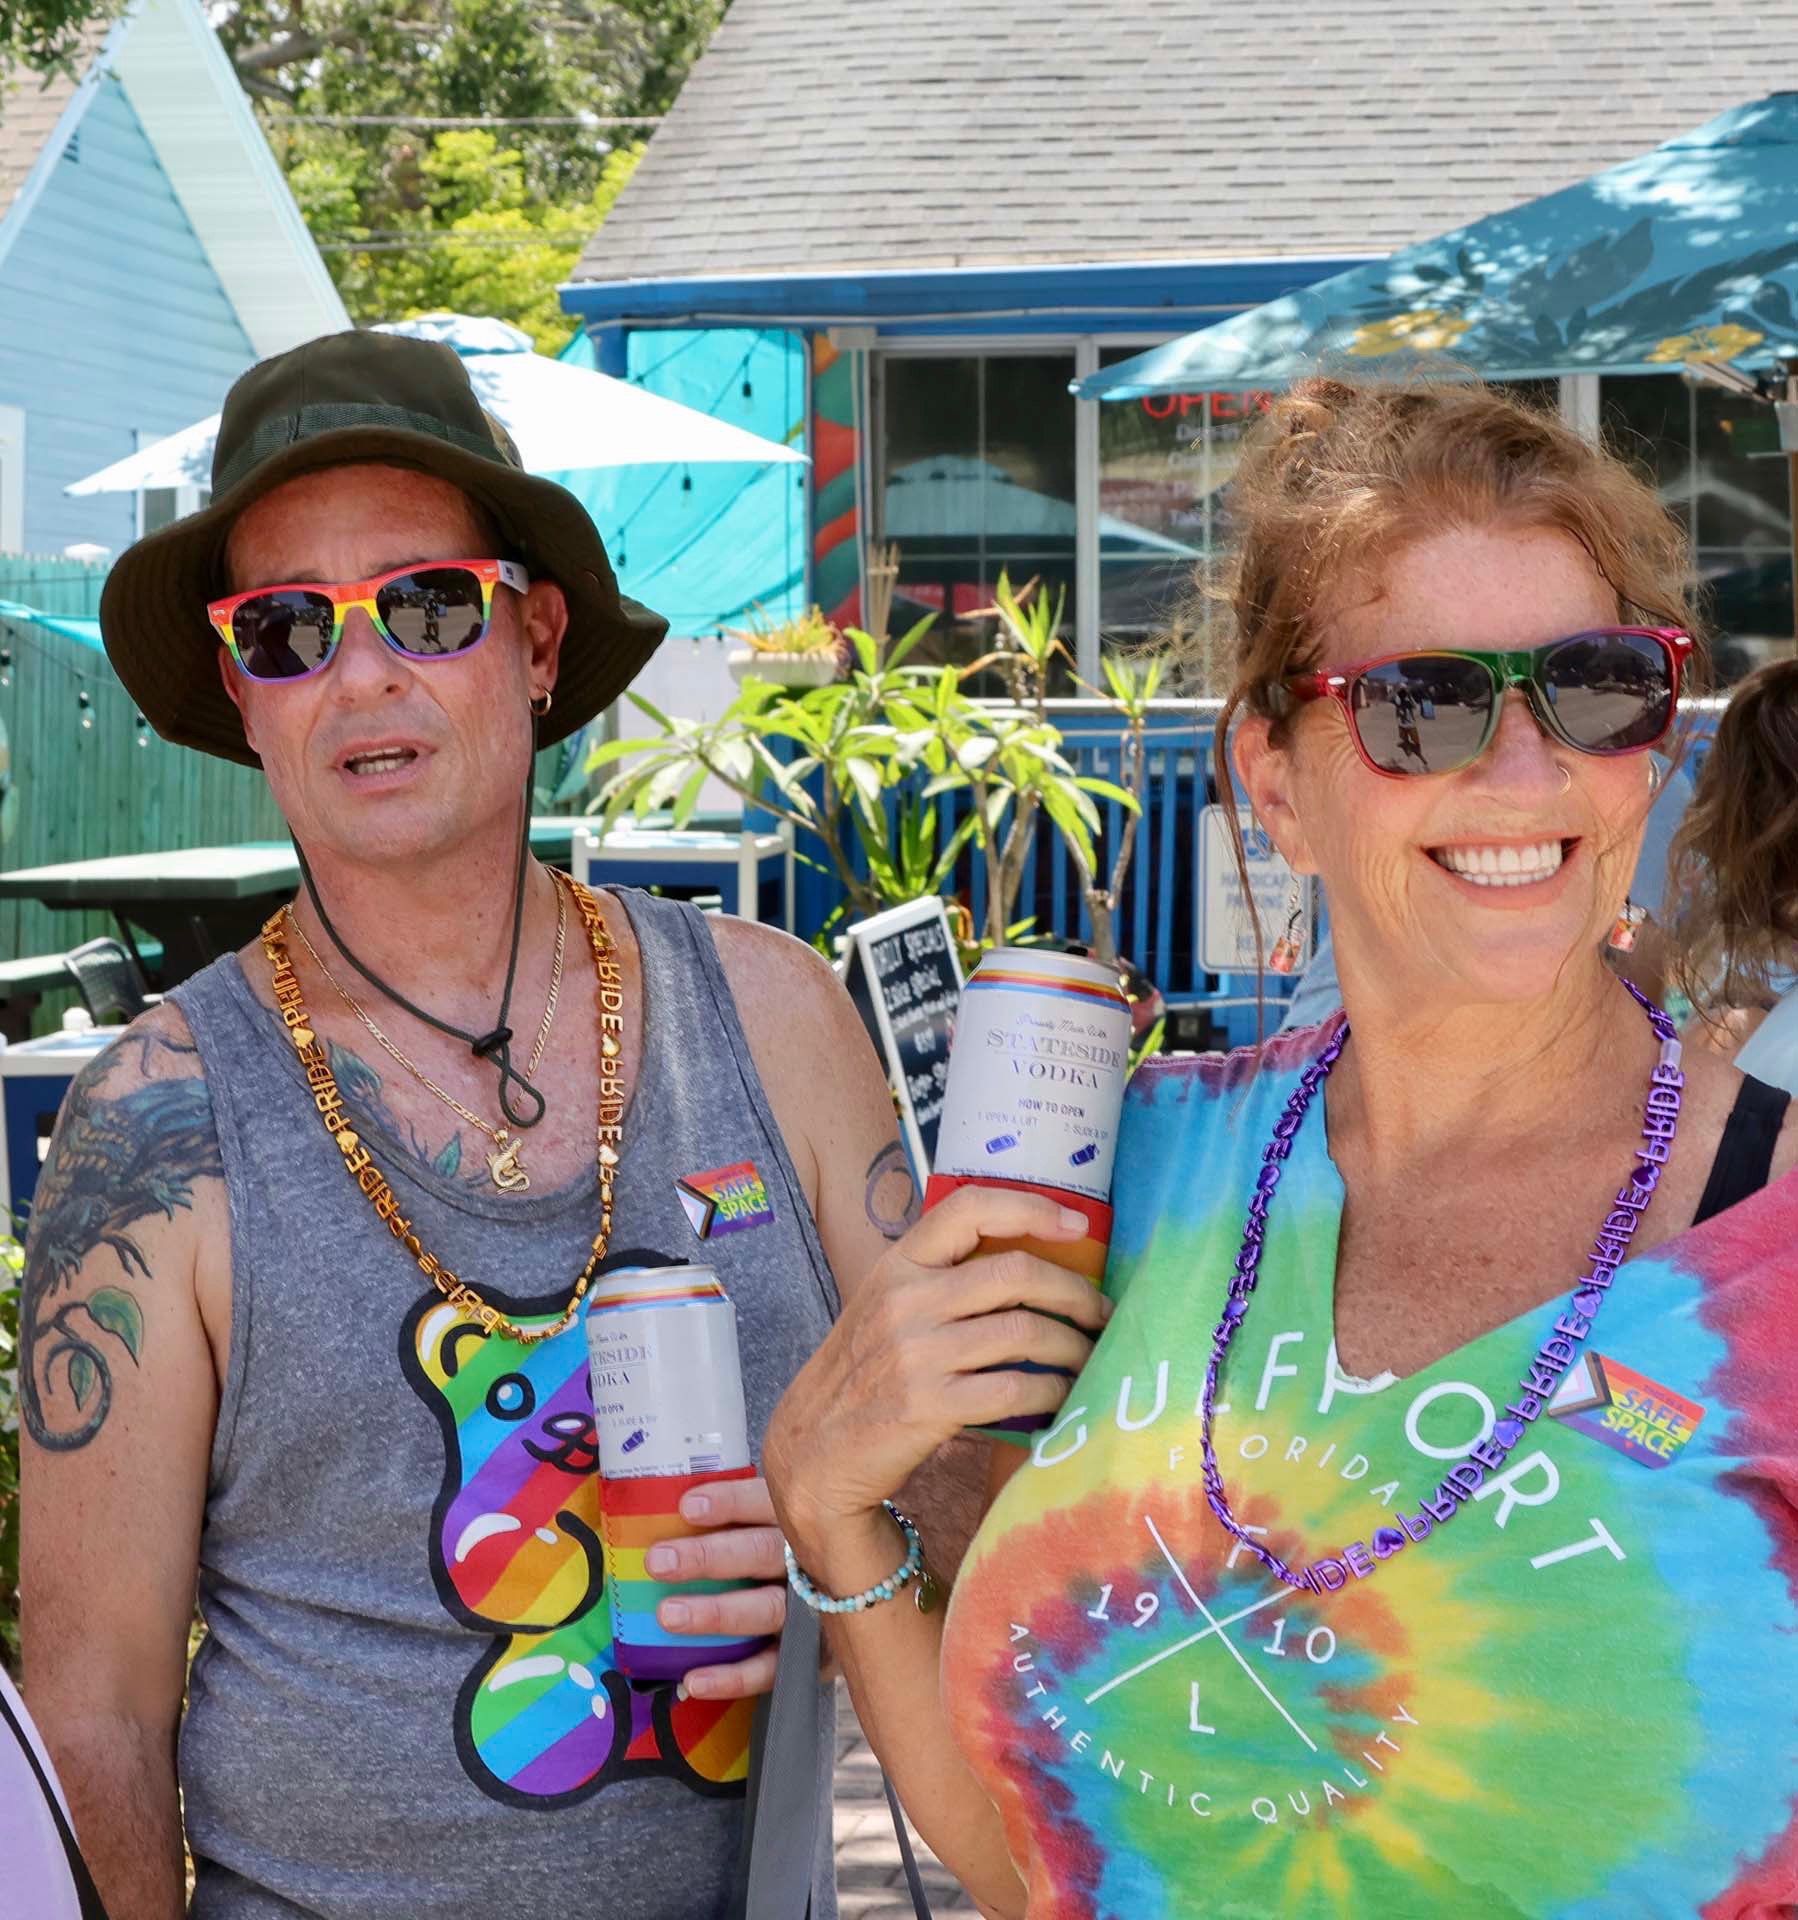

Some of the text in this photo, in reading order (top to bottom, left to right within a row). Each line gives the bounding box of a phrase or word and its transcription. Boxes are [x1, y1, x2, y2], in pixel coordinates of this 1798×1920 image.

[1221, 873, 1288, 886] HADICAP
[985, 1027, 1122, 1069] STATESIDE
[1011, 1059, 1100, 1090] VODKA
[299, 1043, 351, 1134] PRIDE
[1018, 1098, 1086, 1119] HOW TO OPEN
[344, 1147, 413, 1239] PRIDE
[713, 1175, 761, 1202] SAFE
[720, 1194, 770, 1222] SPACE
[1600, 1405, 1678, 1460] SPACE
[1618, 1388, 1687, 1437] SAFE
[1168, 1434, 1400, 1506] FORIDA
[1302, 1541, 1376, 1596] IDE
[1088, 1583, 1336, 1664] 19 10
[1008, 1622, 1420, 1825] AUTHENTIC QUALITY
[1189, 1681, 1216, 1736] L
